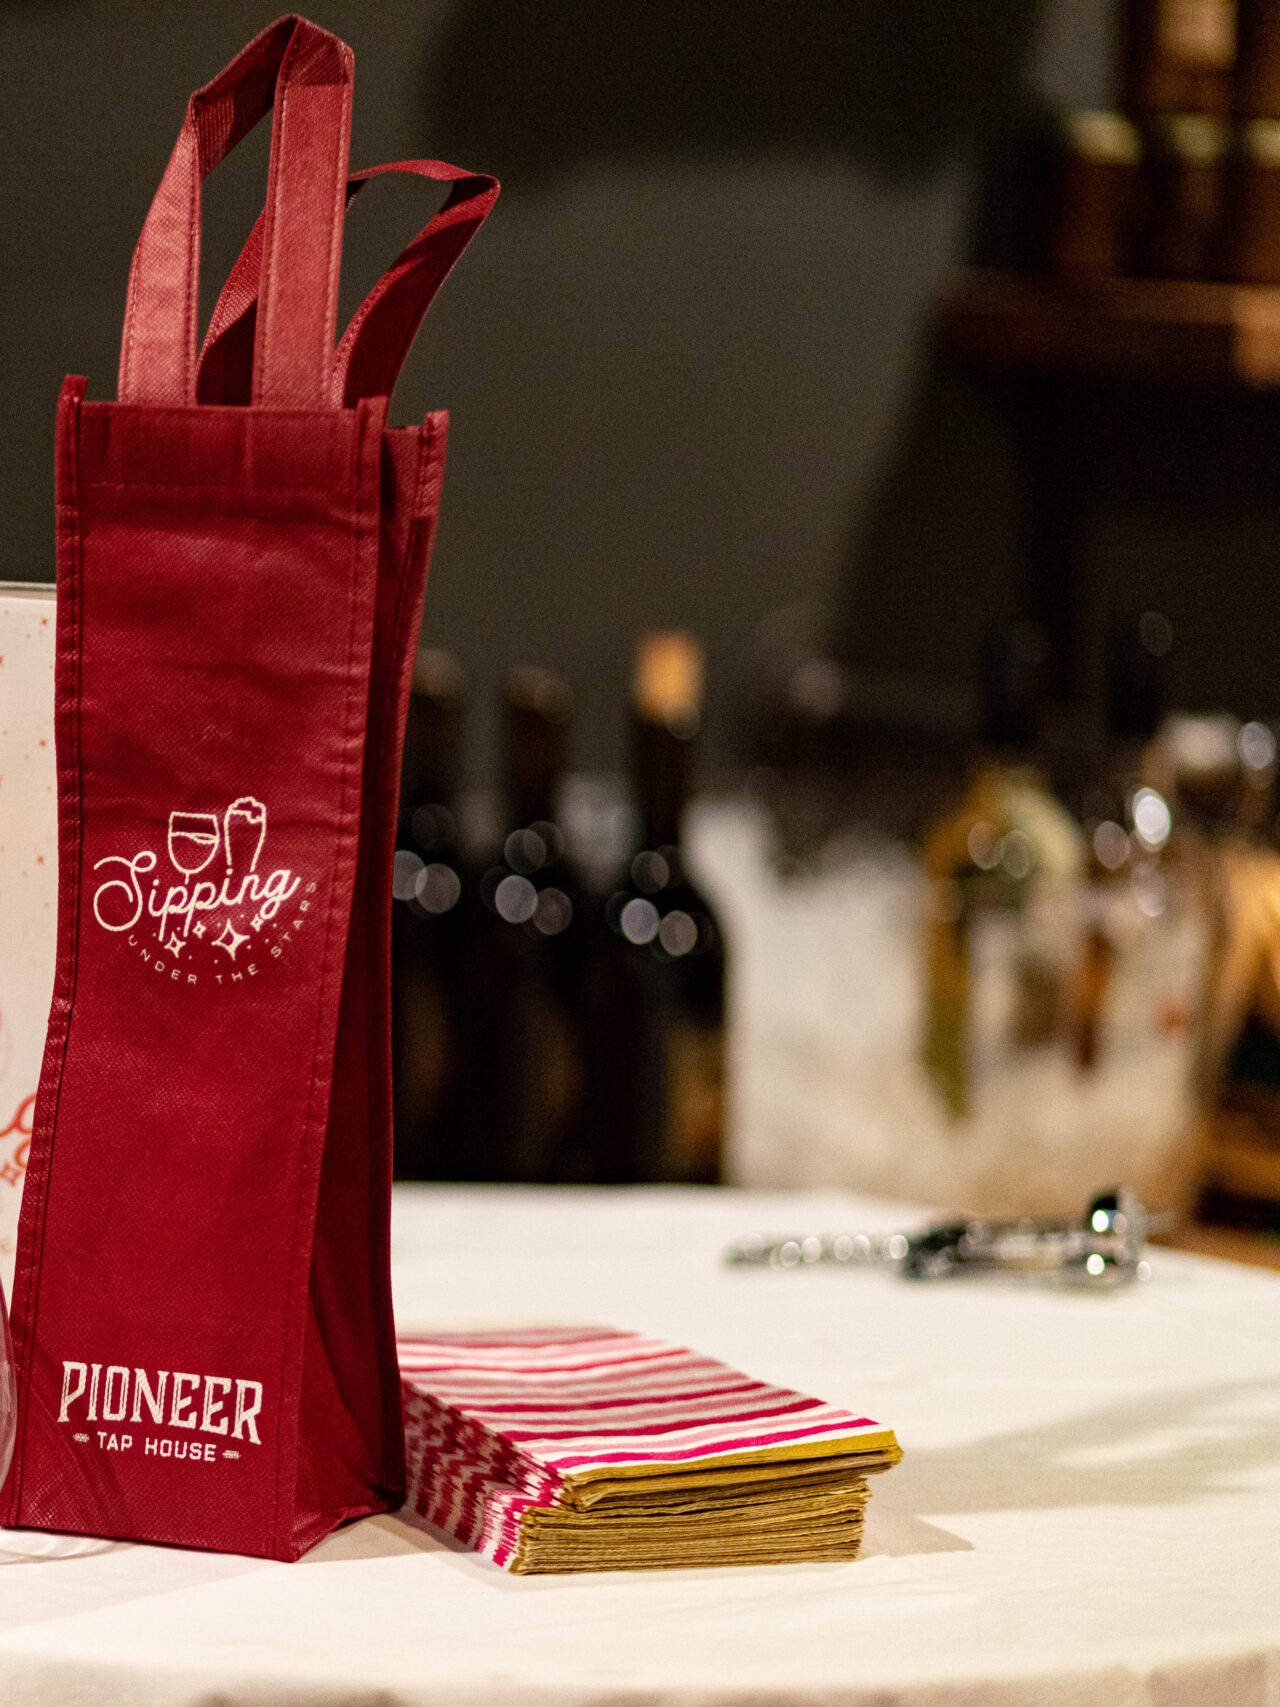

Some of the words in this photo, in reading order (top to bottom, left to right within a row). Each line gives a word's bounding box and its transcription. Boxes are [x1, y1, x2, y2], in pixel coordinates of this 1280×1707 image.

[93, 851, 301, 942] Sipping
[128, 934, 197, 984] UNDER
[216, 963, 259, 984] THE
[271, 882, 316, 958] STARS
[57, 1361, 263, 1445] PIONEER
[97, 1431, 133, 1451] TAP
[145, 1437, 217, 1462] HOUSE
